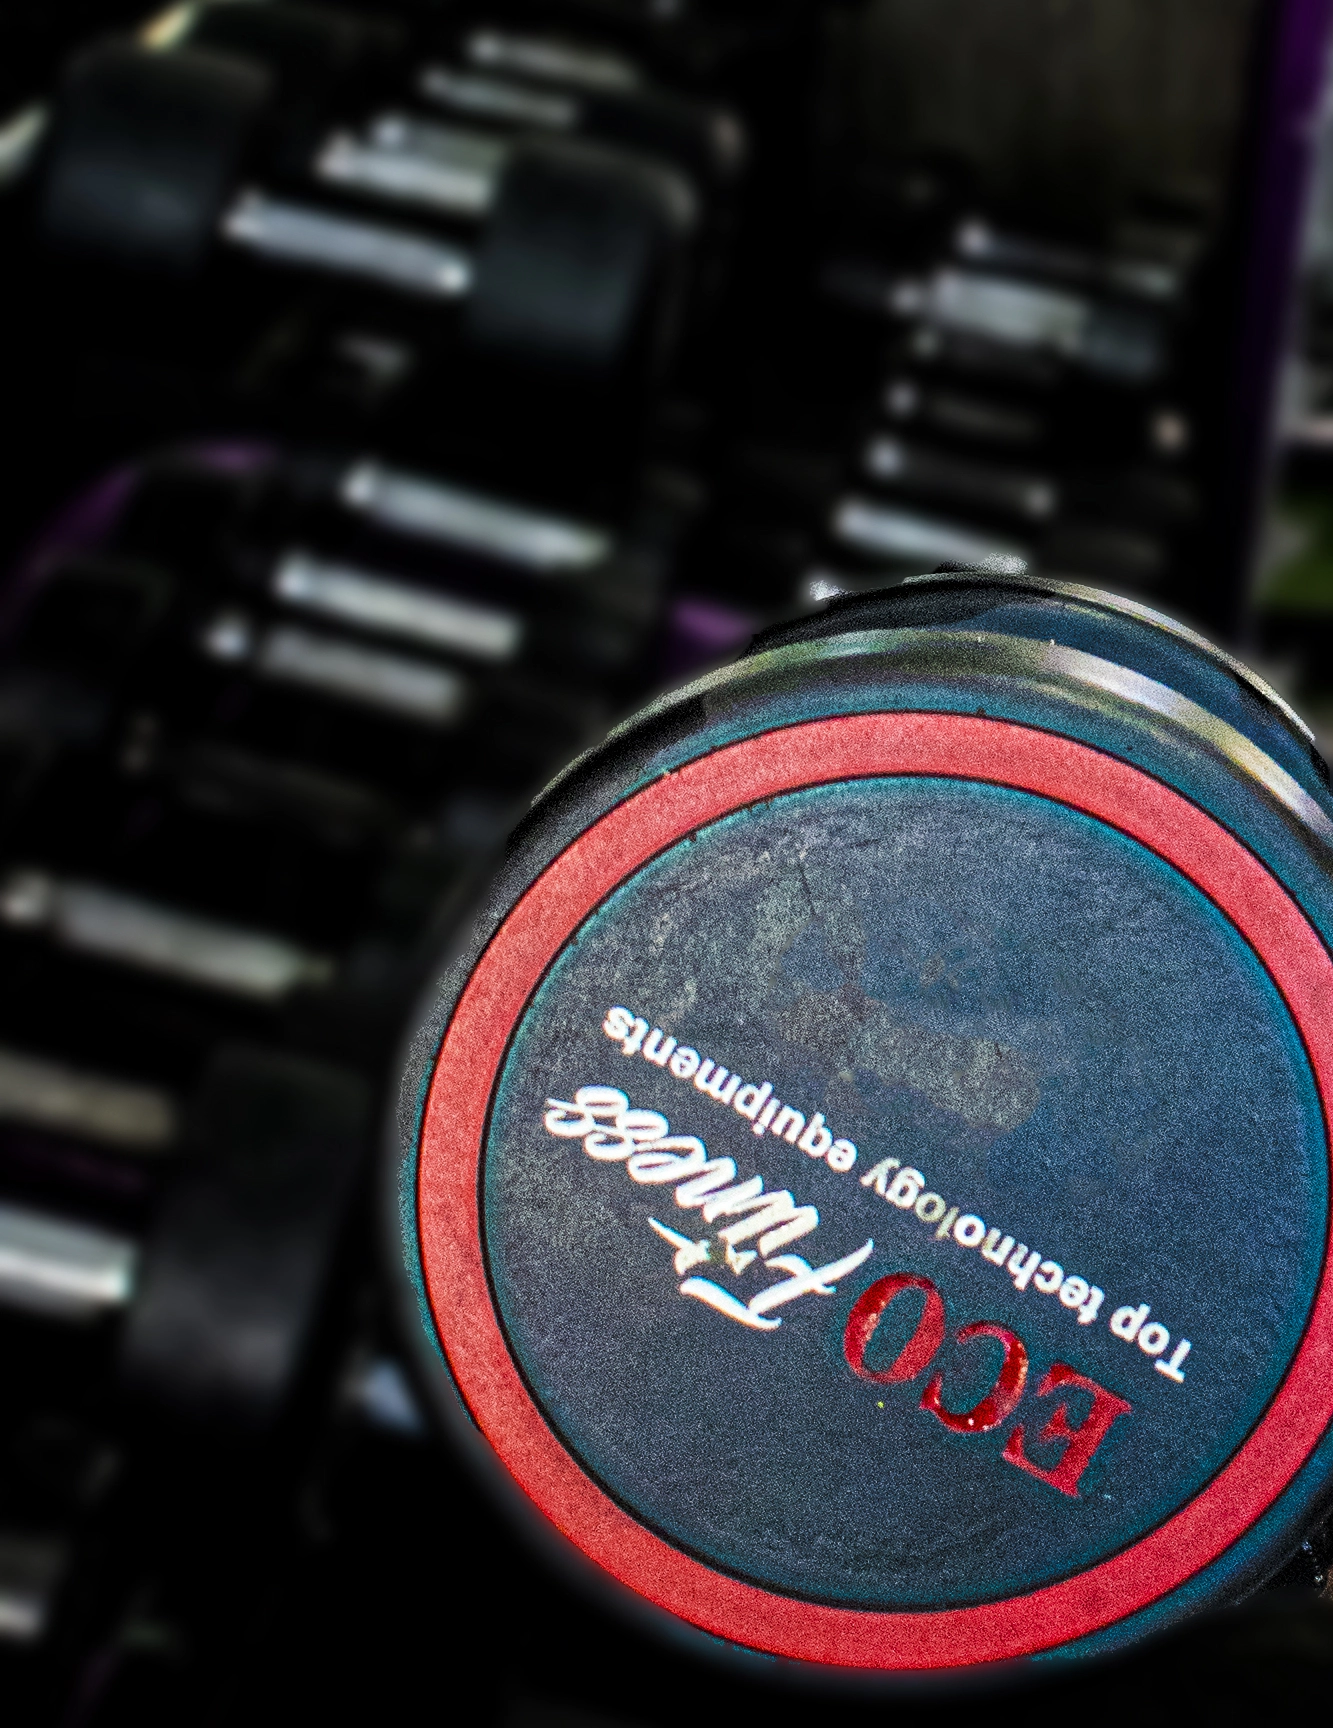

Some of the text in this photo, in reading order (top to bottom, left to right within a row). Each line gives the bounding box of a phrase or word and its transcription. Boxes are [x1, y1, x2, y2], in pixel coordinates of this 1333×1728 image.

[544, 1085, 1132, 1497] ECO Fitness
[602, 1005, 1193, 1382] Top technology equipments
